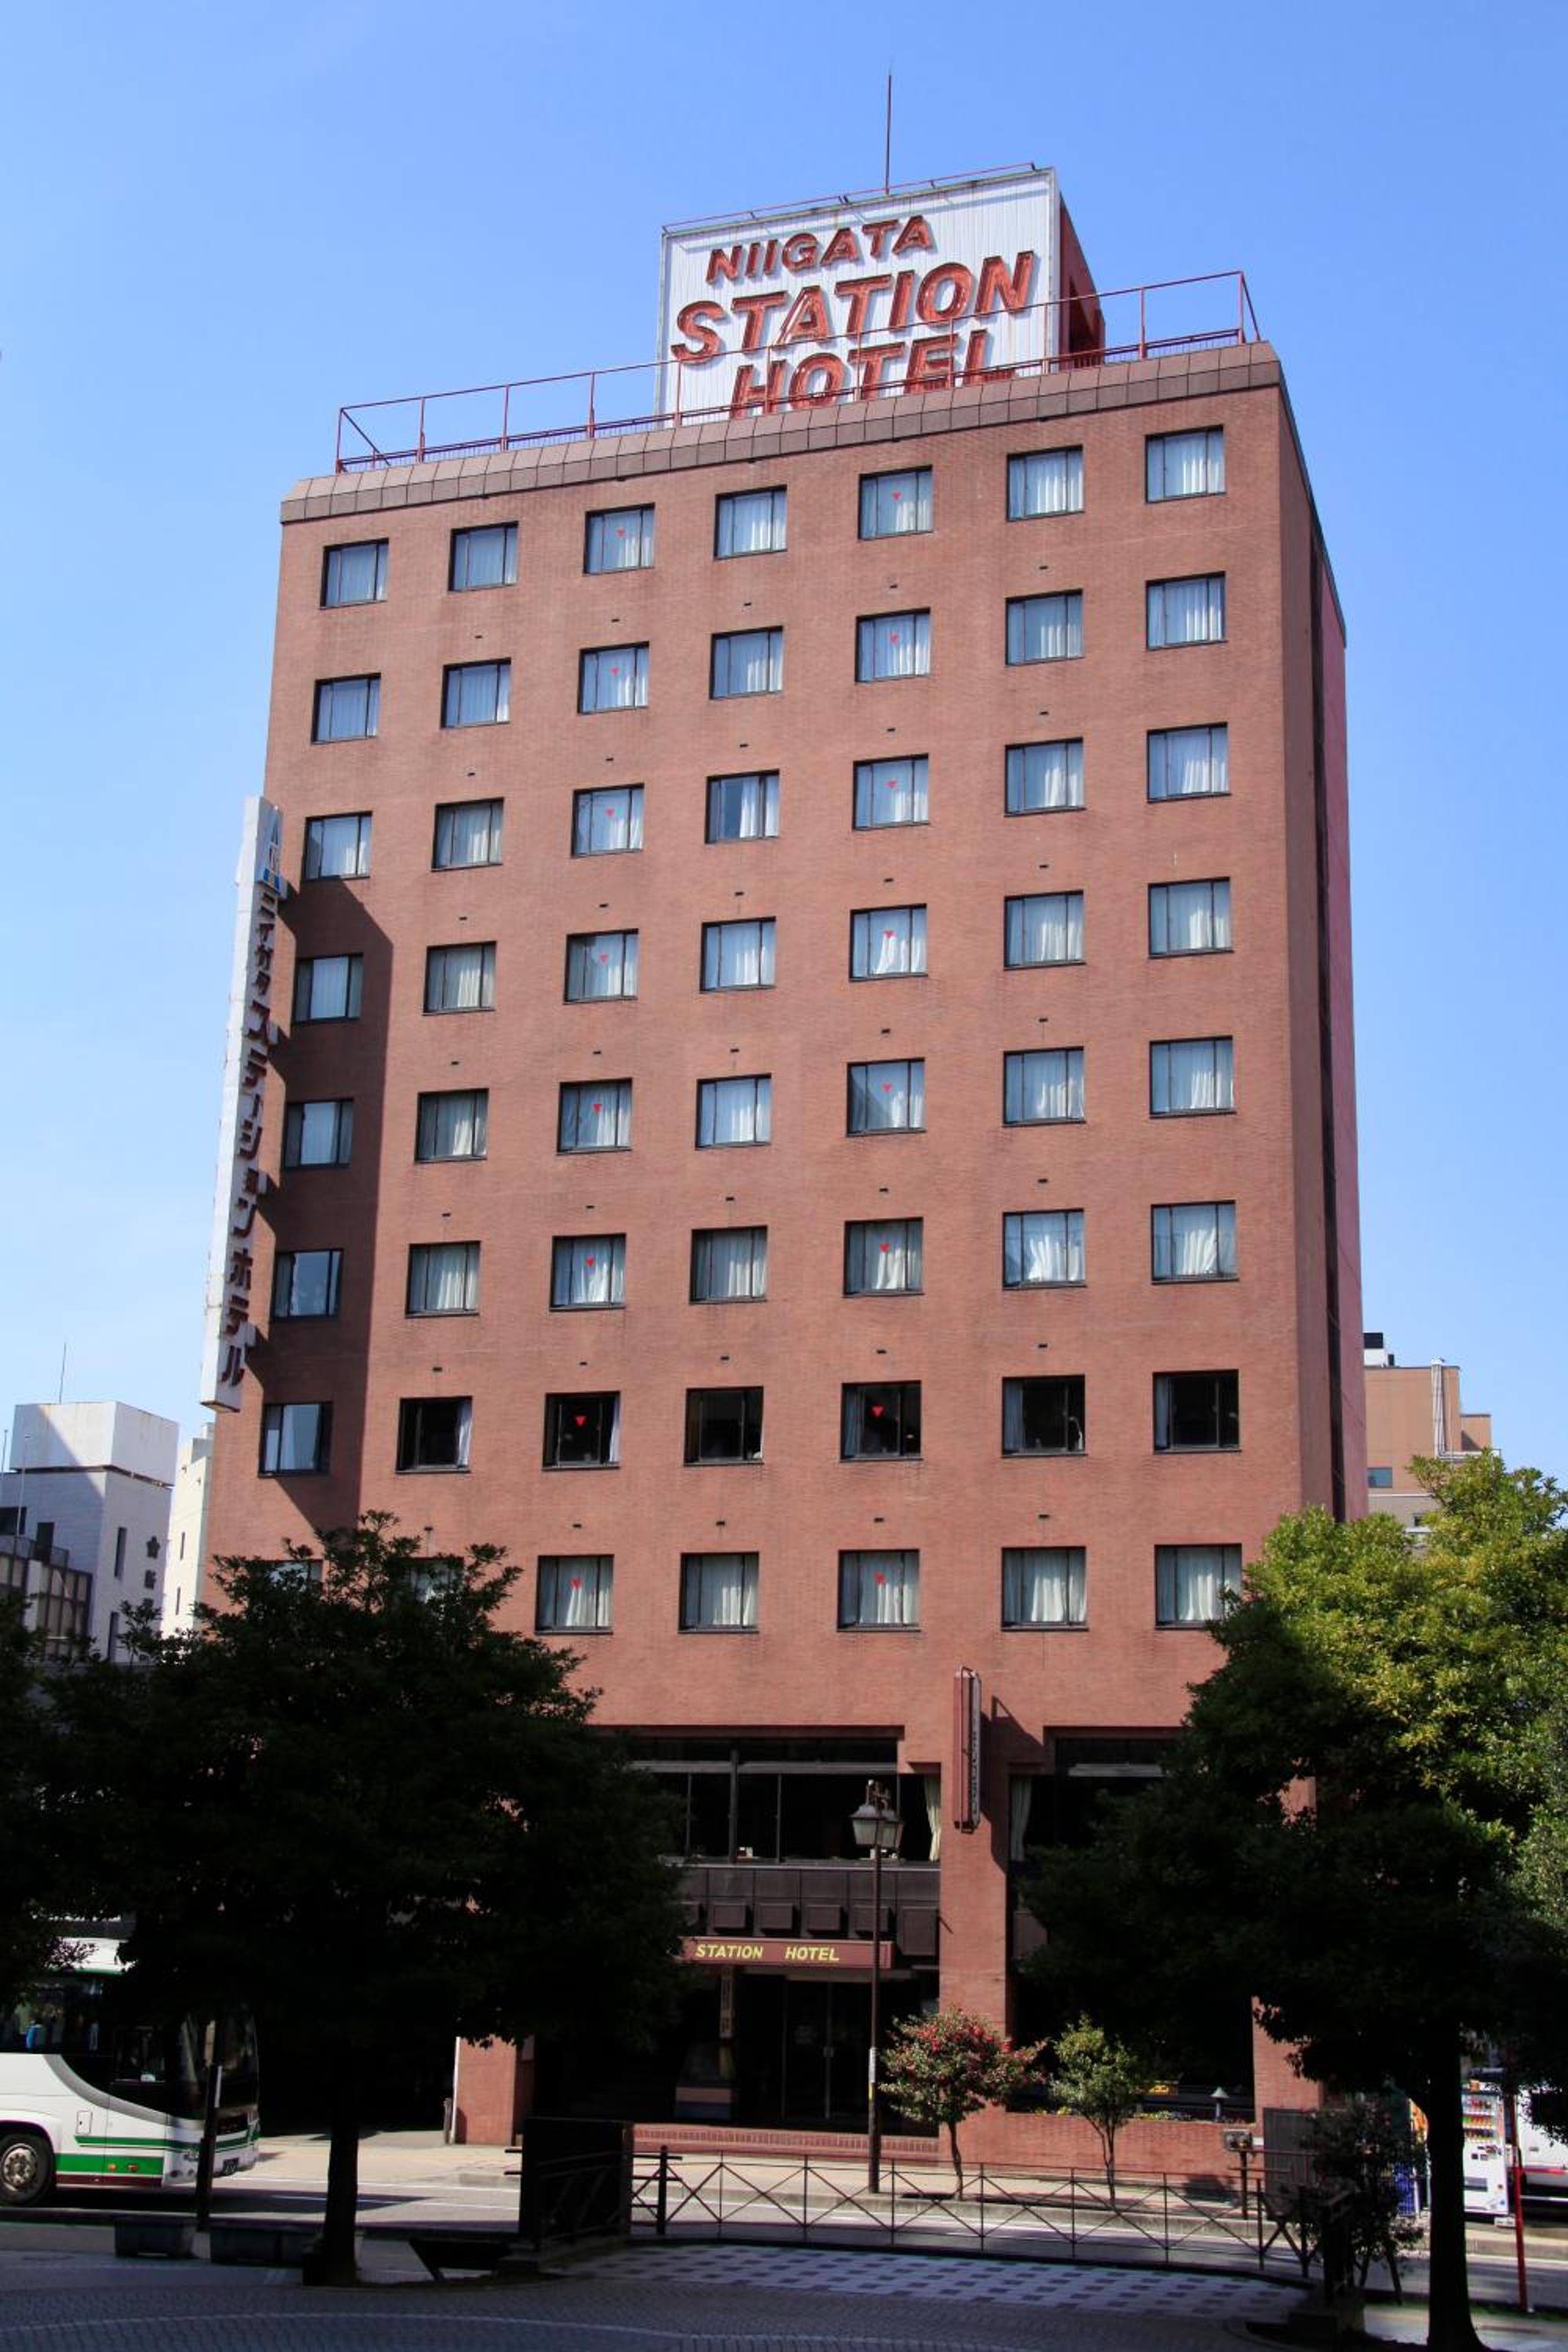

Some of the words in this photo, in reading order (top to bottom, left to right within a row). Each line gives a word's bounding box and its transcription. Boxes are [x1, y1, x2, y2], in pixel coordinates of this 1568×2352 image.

[706, 214, 933, 284] NIIGATA
[671, 250, 1034, 364] STATION
[729, 328, 1016, 419] HOTEL
[695, 1944, 764, 1958] STATION
[785, 1945, 840, 1962] HOTEL
